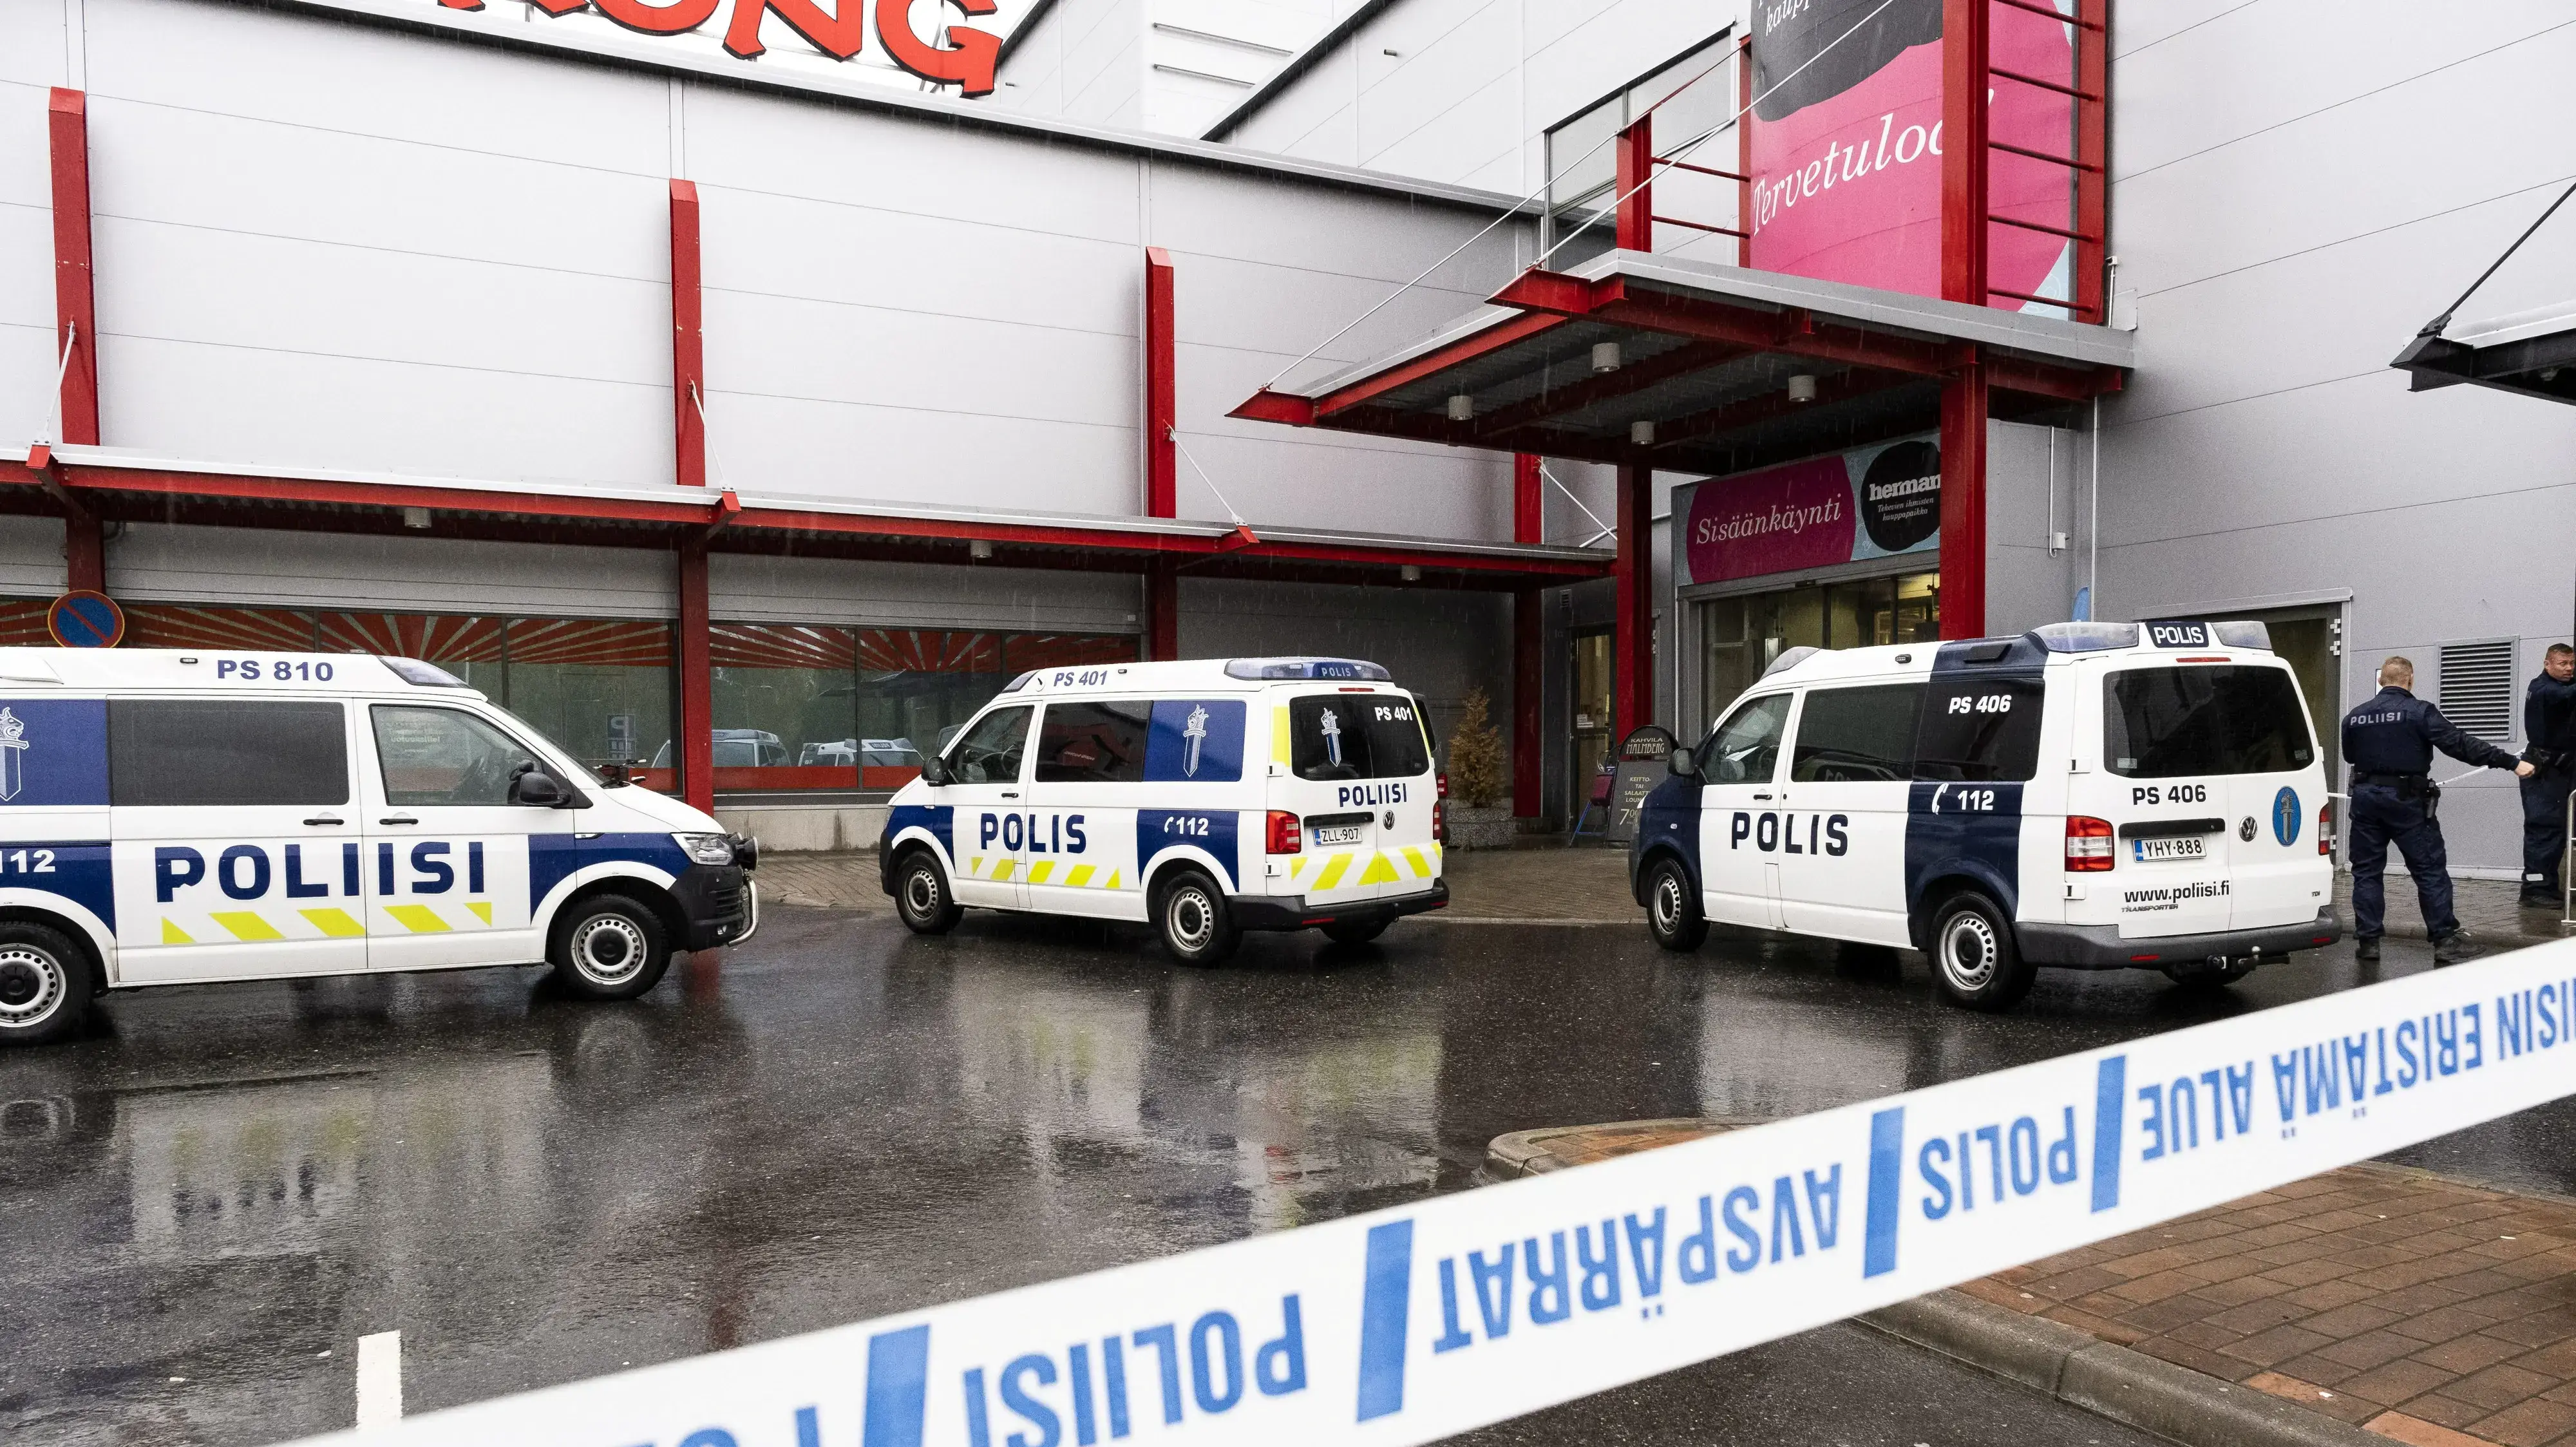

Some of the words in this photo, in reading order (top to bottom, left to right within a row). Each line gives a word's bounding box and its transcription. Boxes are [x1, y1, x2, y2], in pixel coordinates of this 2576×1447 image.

[1766, 0, 1810, 37] kaup
[1878, 503, 1904, 513] Tekevien
[1906, 498, 1933, 507] ihmisten
[1882, 507, 1927, 521] kauppapaikka
[1696, 493, 1841, 544] Sisäänkäynti
[2153, 626, 2204, 645] POLIS
[218, 659, 260, 680] PS
[274, 661, 333, 681] 810
[1054, 672, 1074, 687] PS
[1079, 670, 1108, 686] 401
[1321, 666, 1352, 677] POLIS
[1374, 707, 1392, 721] PS
[1394, 707, 1413, 721] 401
[1948, 697, 1972, 714] PS
[1975, 695, 2012, 713] 406
[2351, 712, 2401, 726] POLIISI
[1627, 743, 1664, 754] MALMBERG
[1338, 783, 1407, 807] POLIISI
[1958, 790, 1994, 811] 112
[2132, 787, 2160, 805] PS
[2167, 784, 2206, 804] 406
[981, 813, 1086, 853] POLIS
[1176, 816, 1208, 835] 112
[1731, 812, 1848, 856] POLIS
[0, 849, 55, 873] 12
[155, 841, 484, 902] POLIISI
[2125, 880, 2230, 903] www.poliisi.fi
[2121, 903, 2178, 913] TRANSPORTER
[2271, 1003, 2483, 1139] ERISTÄMÄ
[2139, 1061, 2254, 1160] ALUE
[1919, 1104, 2078, 1220] POLIS
[1432, 1164, 1842, 1354] AVSPÄRRAT
[962, 1293, 1307, 1447] POLIISI
